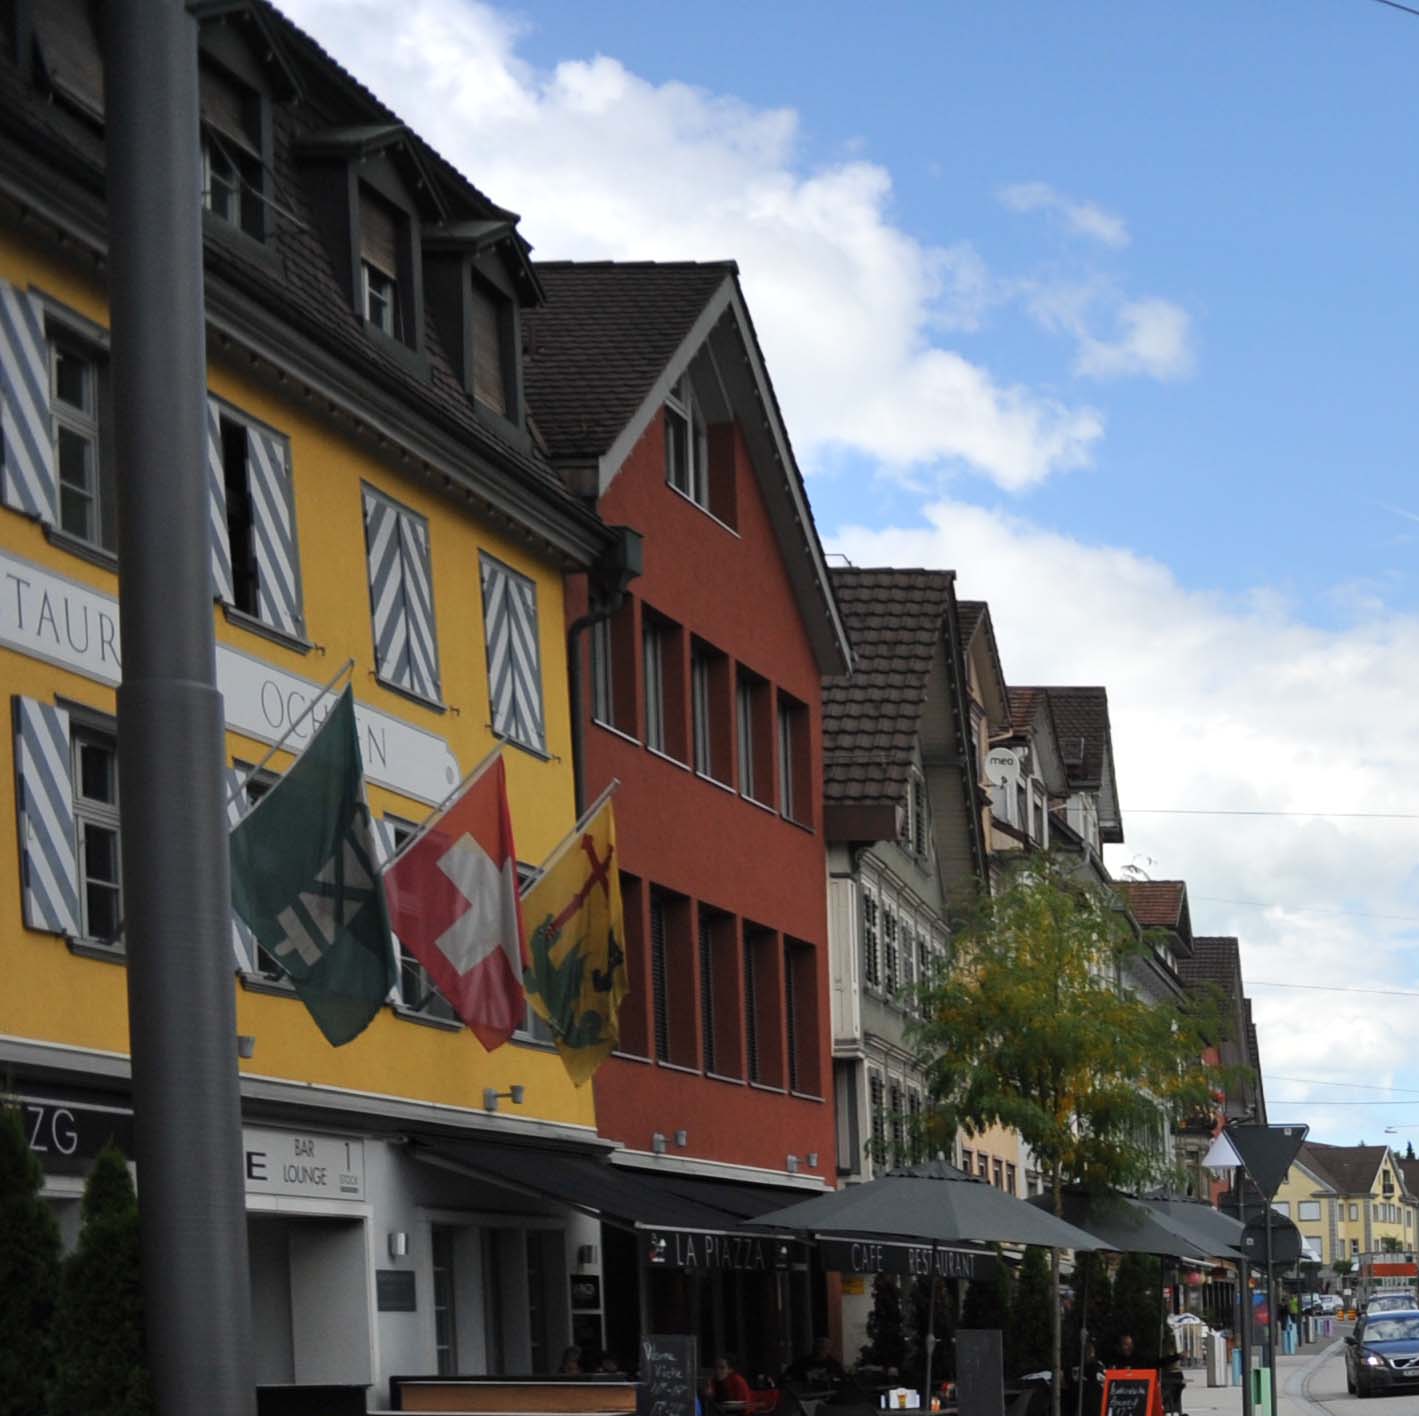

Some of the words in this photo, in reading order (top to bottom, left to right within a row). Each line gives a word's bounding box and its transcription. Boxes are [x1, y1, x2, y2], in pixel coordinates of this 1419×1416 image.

[6, 573, 121, 669] TAUR
[261, 680, 387, 768] OCHN
[294, 1139, 315, 1157] BAR
[282, 1164, 328, 1186] LOUNGE
[675, 1232, 697, 1267] LA
[704, 1235, 766, 1270] PIAZZA
[907, 1248, 976, 1279] RESTAURANT
